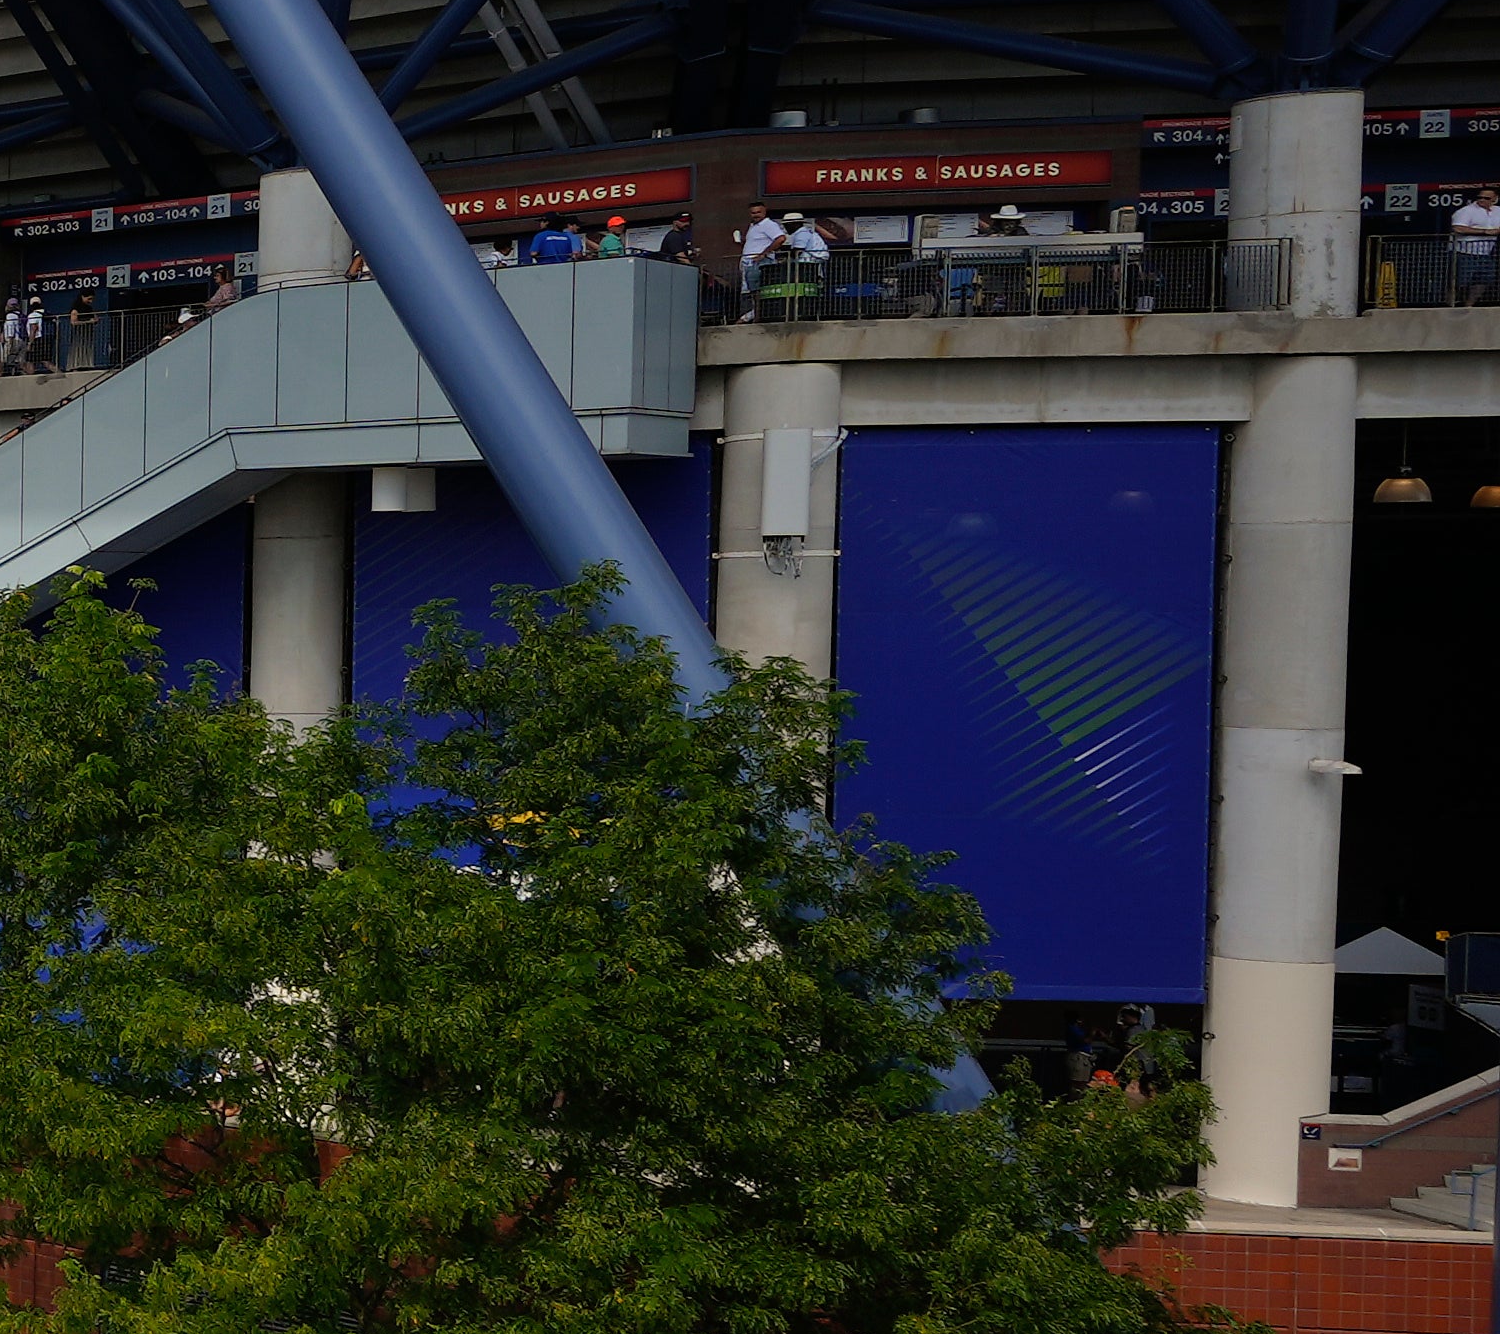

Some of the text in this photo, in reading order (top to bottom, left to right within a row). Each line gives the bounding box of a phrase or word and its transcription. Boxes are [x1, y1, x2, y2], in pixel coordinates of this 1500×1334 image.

[1424, 121, 1445, 133] 22
[1468, 119, 1500, 132] 305
[1172, 130, 1203, 143] 304
[816, 163, 1061, 183] FRANKS & SAUSAGES
[445, 183, 637, 216] NKS & SAUSAGES
[1391, 195, 1413, 207] 22
[1428, 194, 1464, 207] 305
[210, 204, 225, 215] 21
[1171, 201, 1205, 214] 305
[132, 208, 187, 224] 103 104
[27, 221, 80, 236] 302 303
[94, 218, 109, 228] 21
[151, 264, 212, 282] 103 104
[238, 262, 254, 273] 21
[42, 276, 100, 292] 302 303
[111, 274, 126, 285] 21
